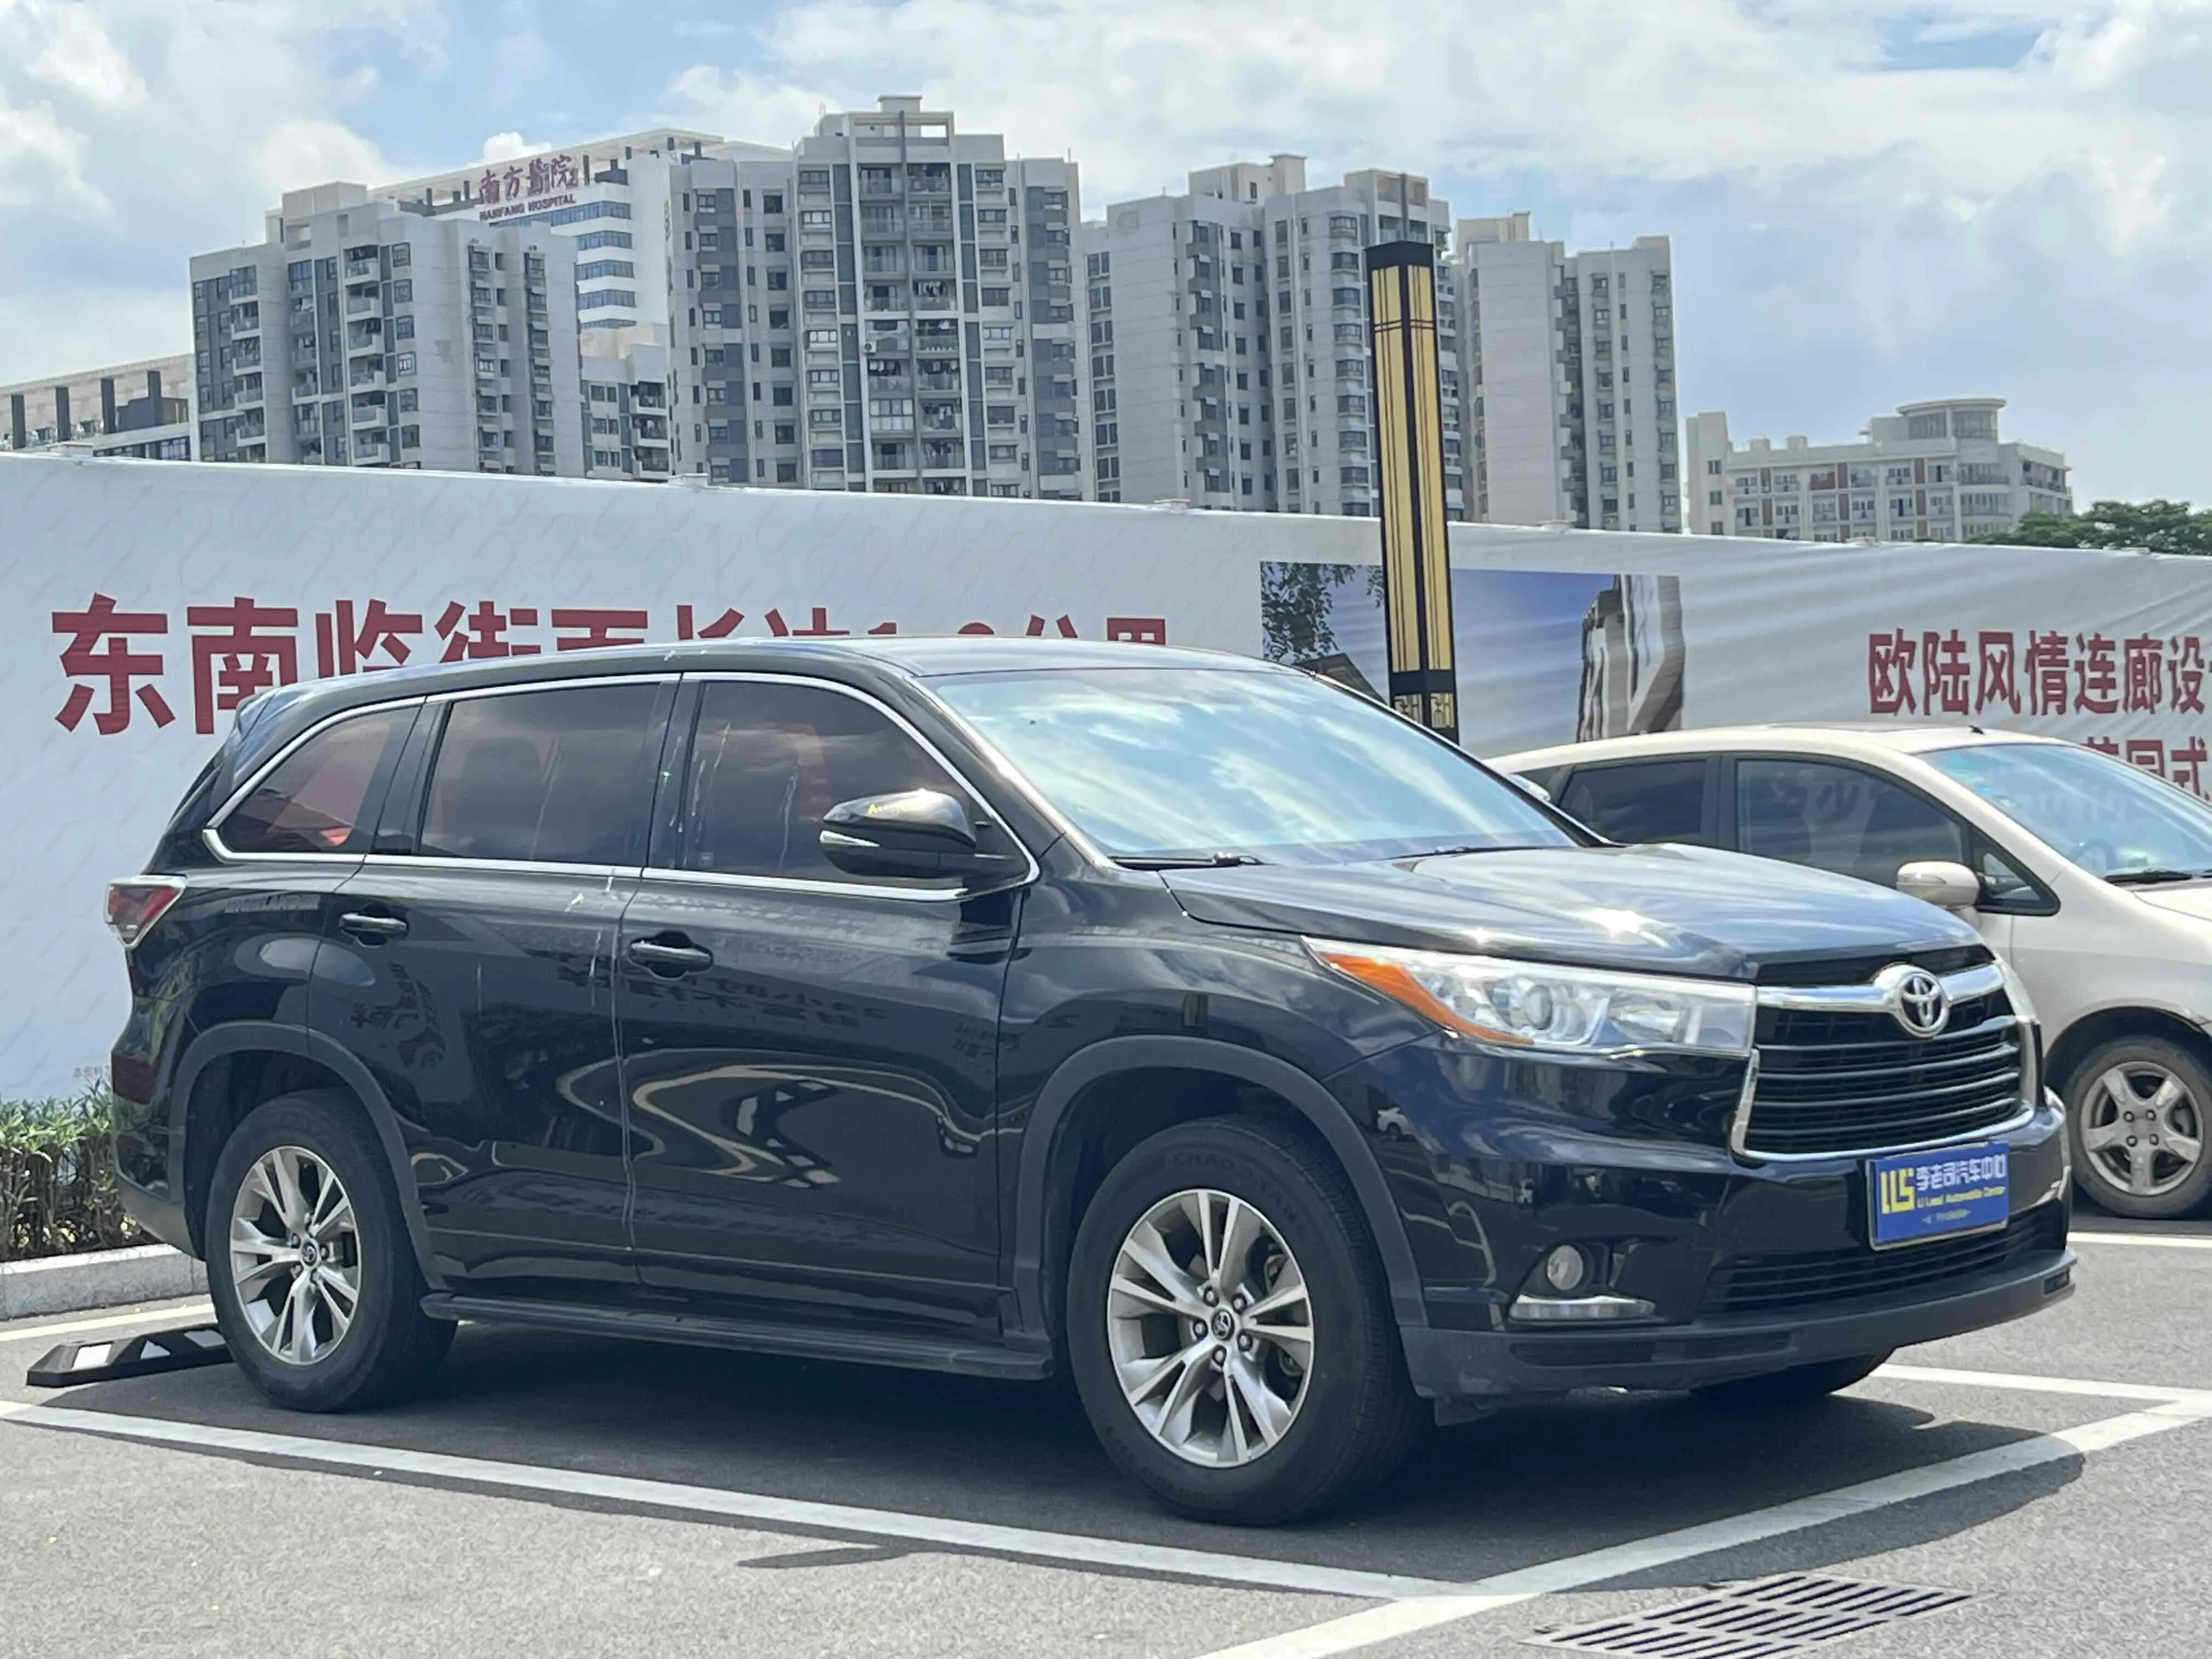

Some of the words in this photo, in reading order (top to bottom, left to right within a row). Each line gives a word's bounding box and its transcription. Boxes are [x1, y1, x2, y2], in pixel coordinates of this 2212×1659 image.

[528, 194, 575, 212] HOSPITAL
[1869, 628, 2212, 715] 欧陆风情连廊设
